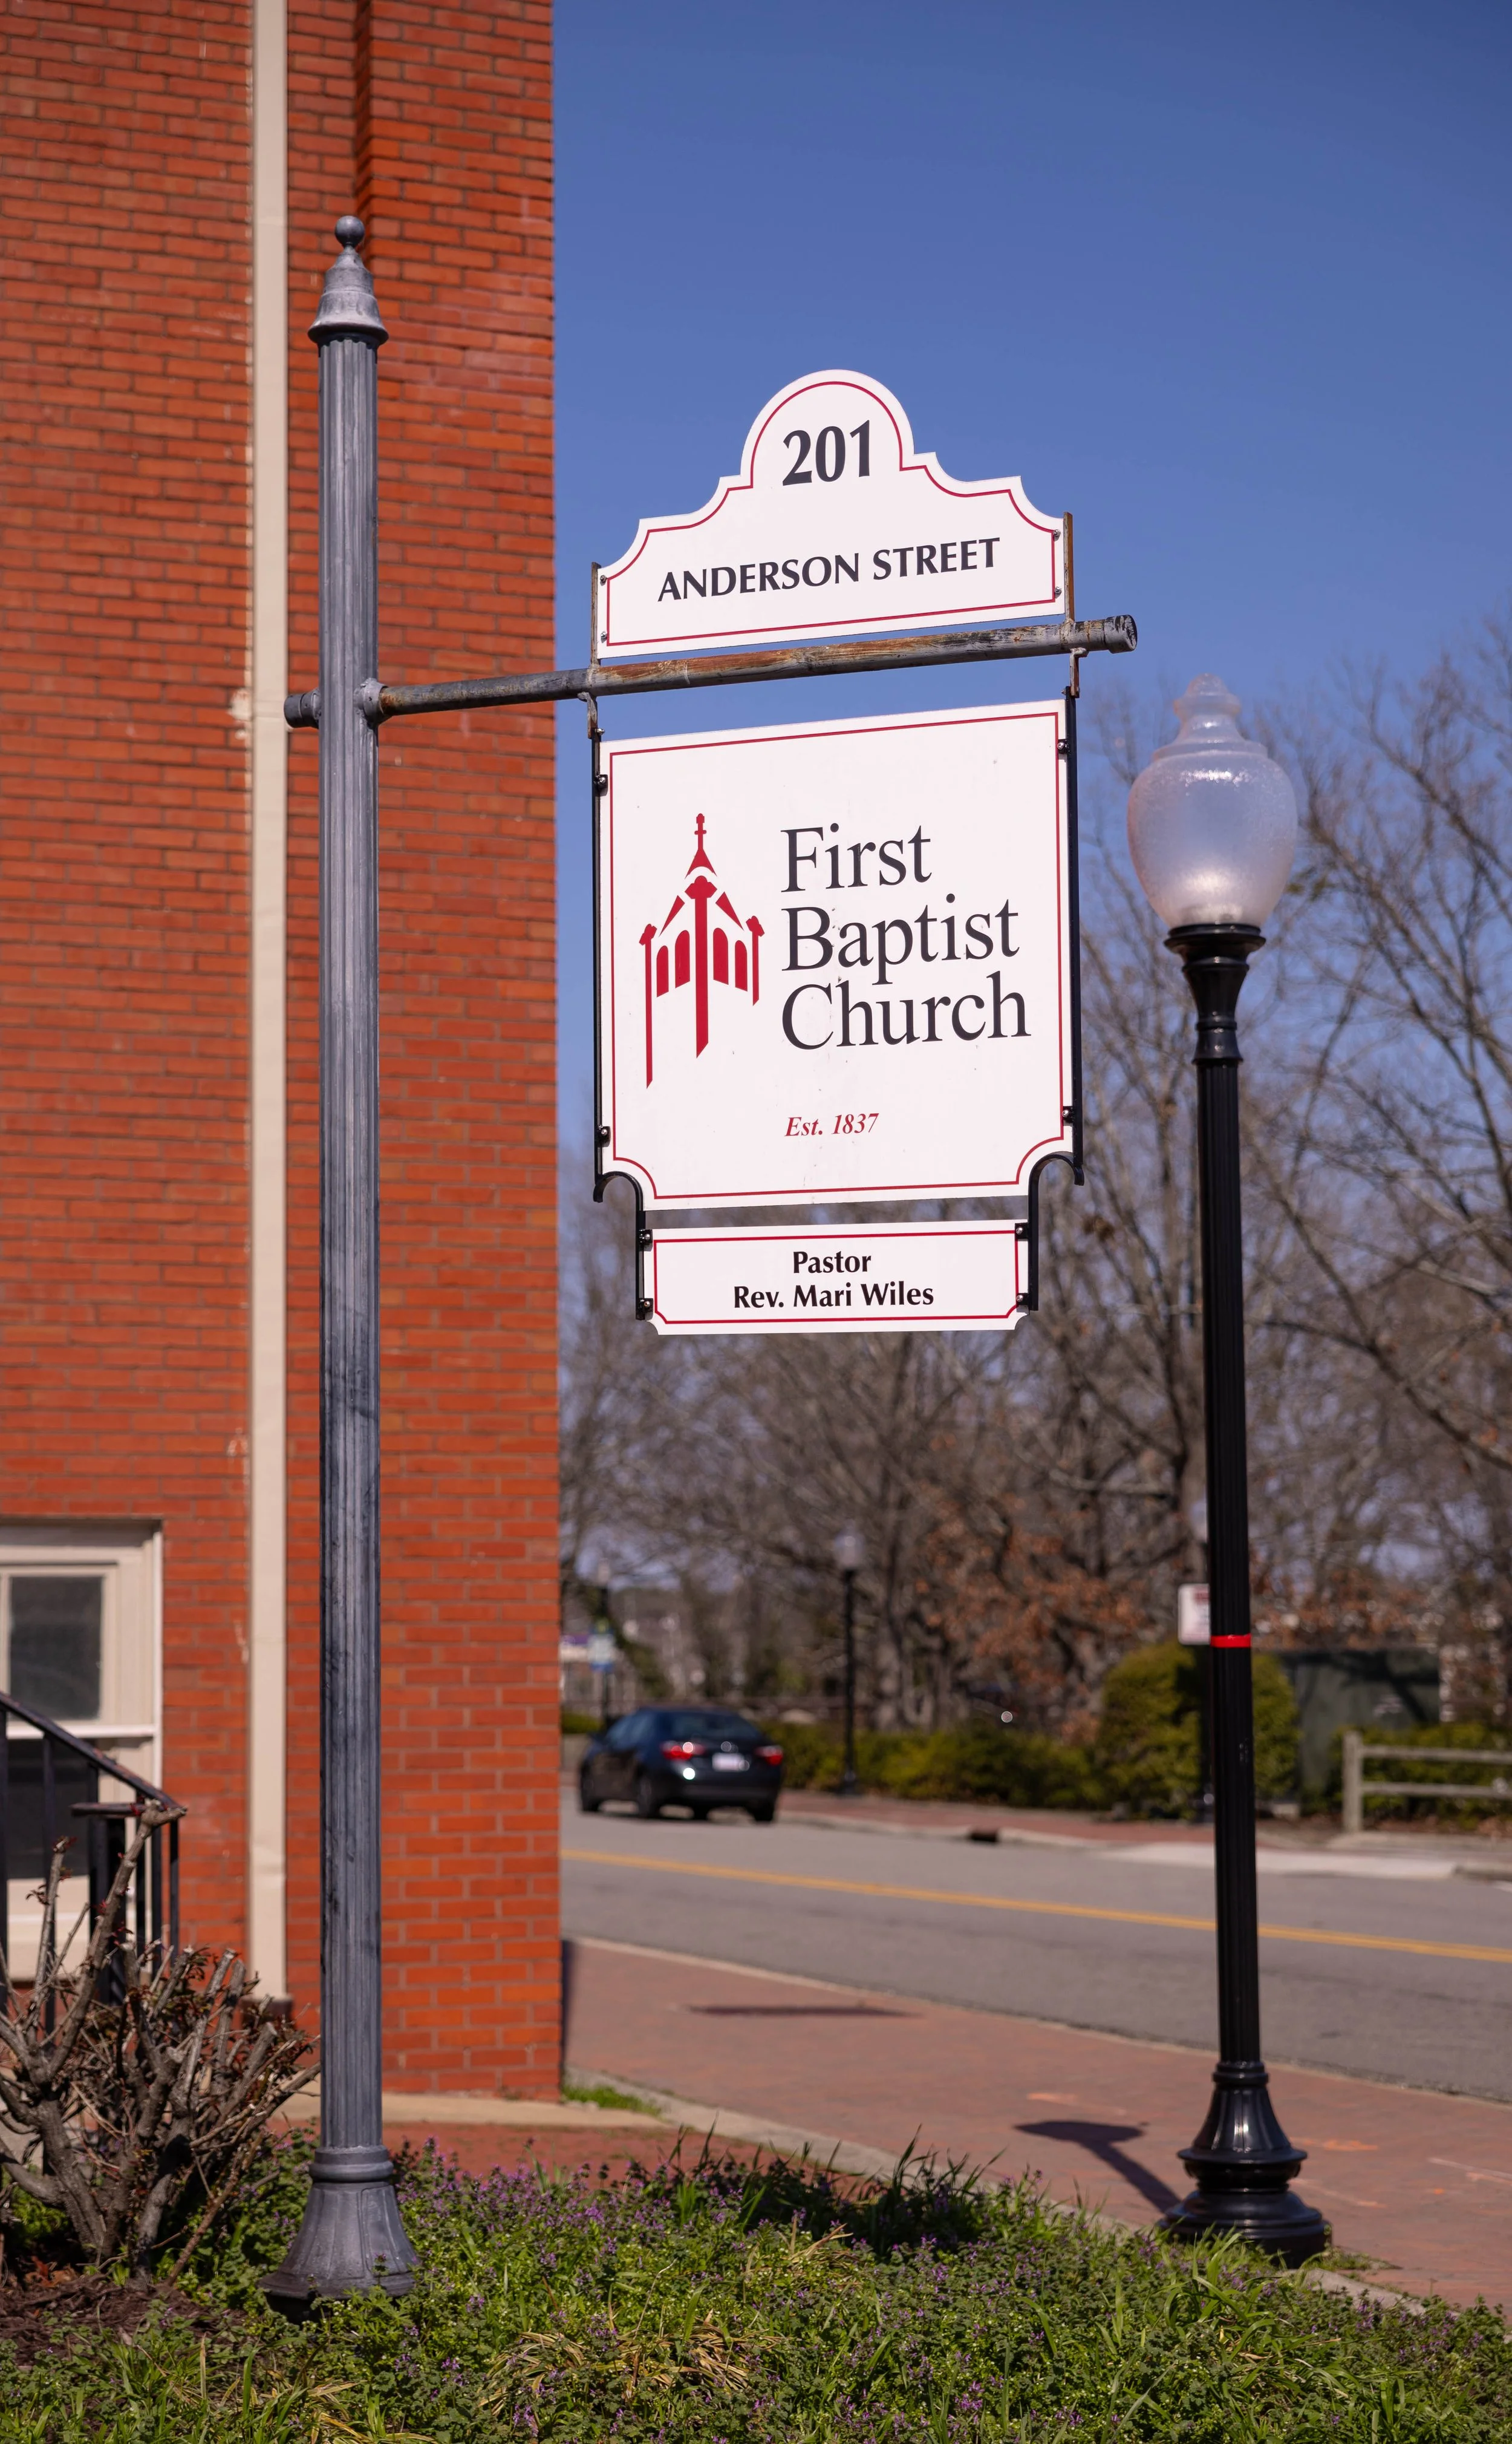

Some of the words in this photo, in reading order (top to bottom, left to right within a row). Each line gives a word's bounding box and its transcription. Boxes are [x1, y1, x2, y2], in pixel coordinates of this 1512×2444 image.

[781, 420, 870, 486] 201
[657, 553, 859, 602] ANDERSON
[873, 537, 1000, 580] STREET
[780, 823, 932, 893] First
[781, 893, 1020, 985] Baptist
[781, 970, 1032, 1050] Church
[784, 1116, 824, 1137] Est.
[832, 1113, 880, 1135] 1837
[734, 1285, 784, 1309] Rev.
[793, 1281, 852, 1308] Mari
[859, 1280, 934, 1307] Wiles
[793, 1250, 872, 1274] Pastor
